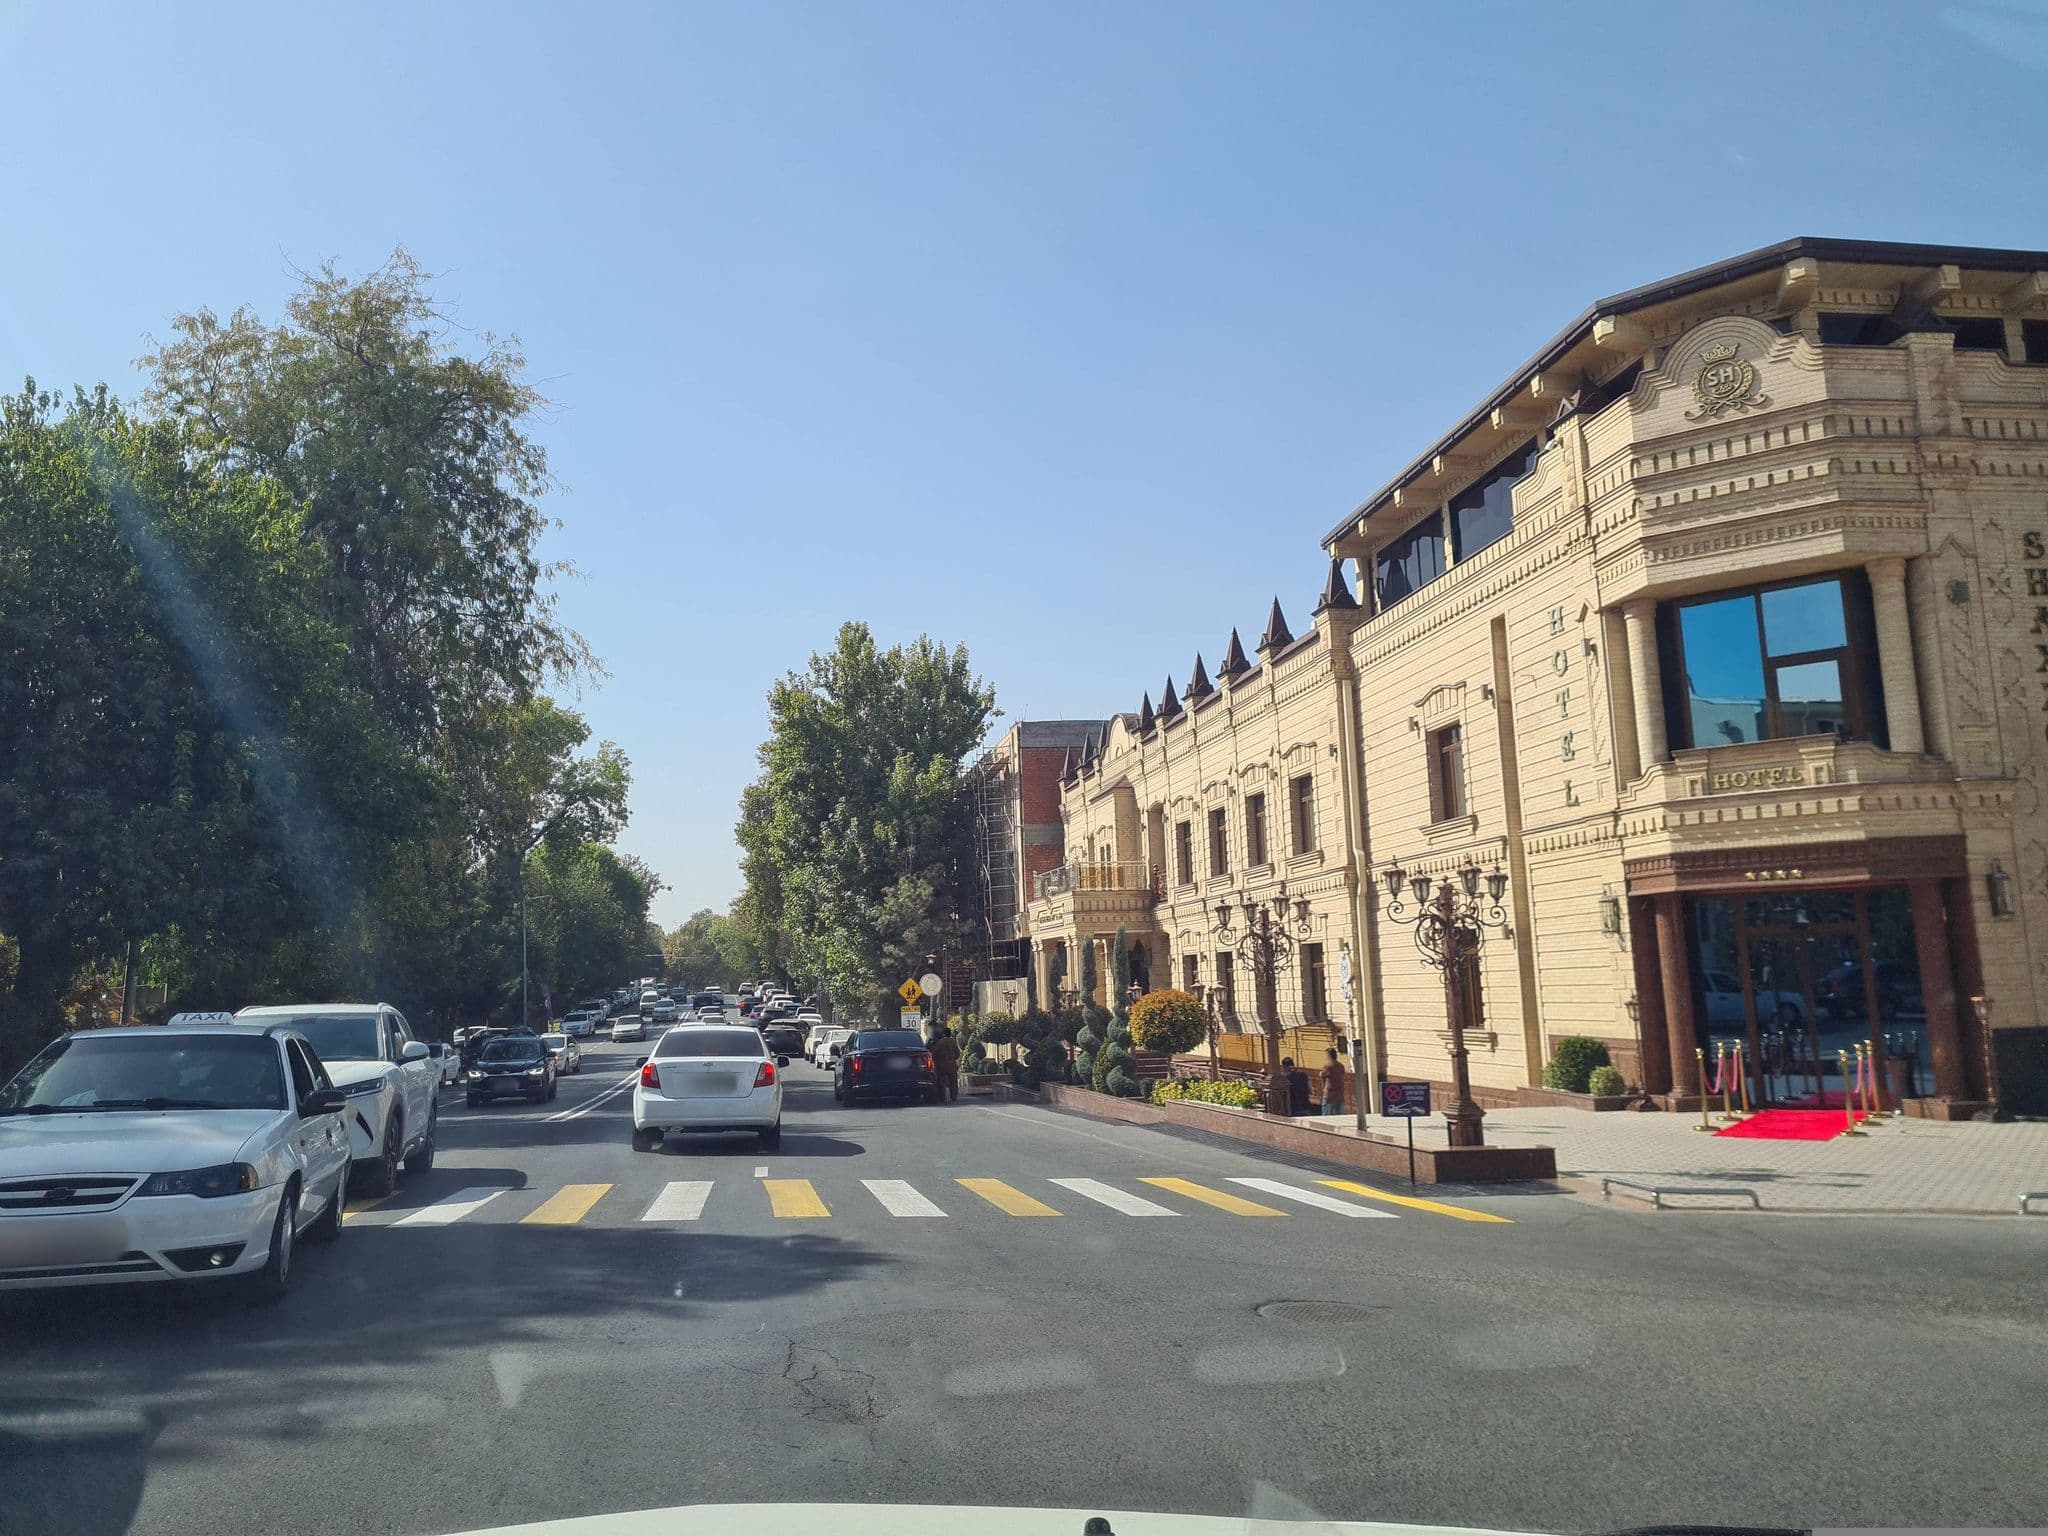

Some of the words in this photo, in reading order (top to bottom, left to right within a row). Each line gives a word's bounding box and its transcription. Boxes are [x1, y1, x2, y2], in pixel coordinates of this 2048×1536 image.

[1707, 366, 1735, 386] SH
[1549, 606, 1581, 807] HOTEL
[1713, 767, 1803, 789] HOTEL
[181, 1013, 224, 1021] TAXI
